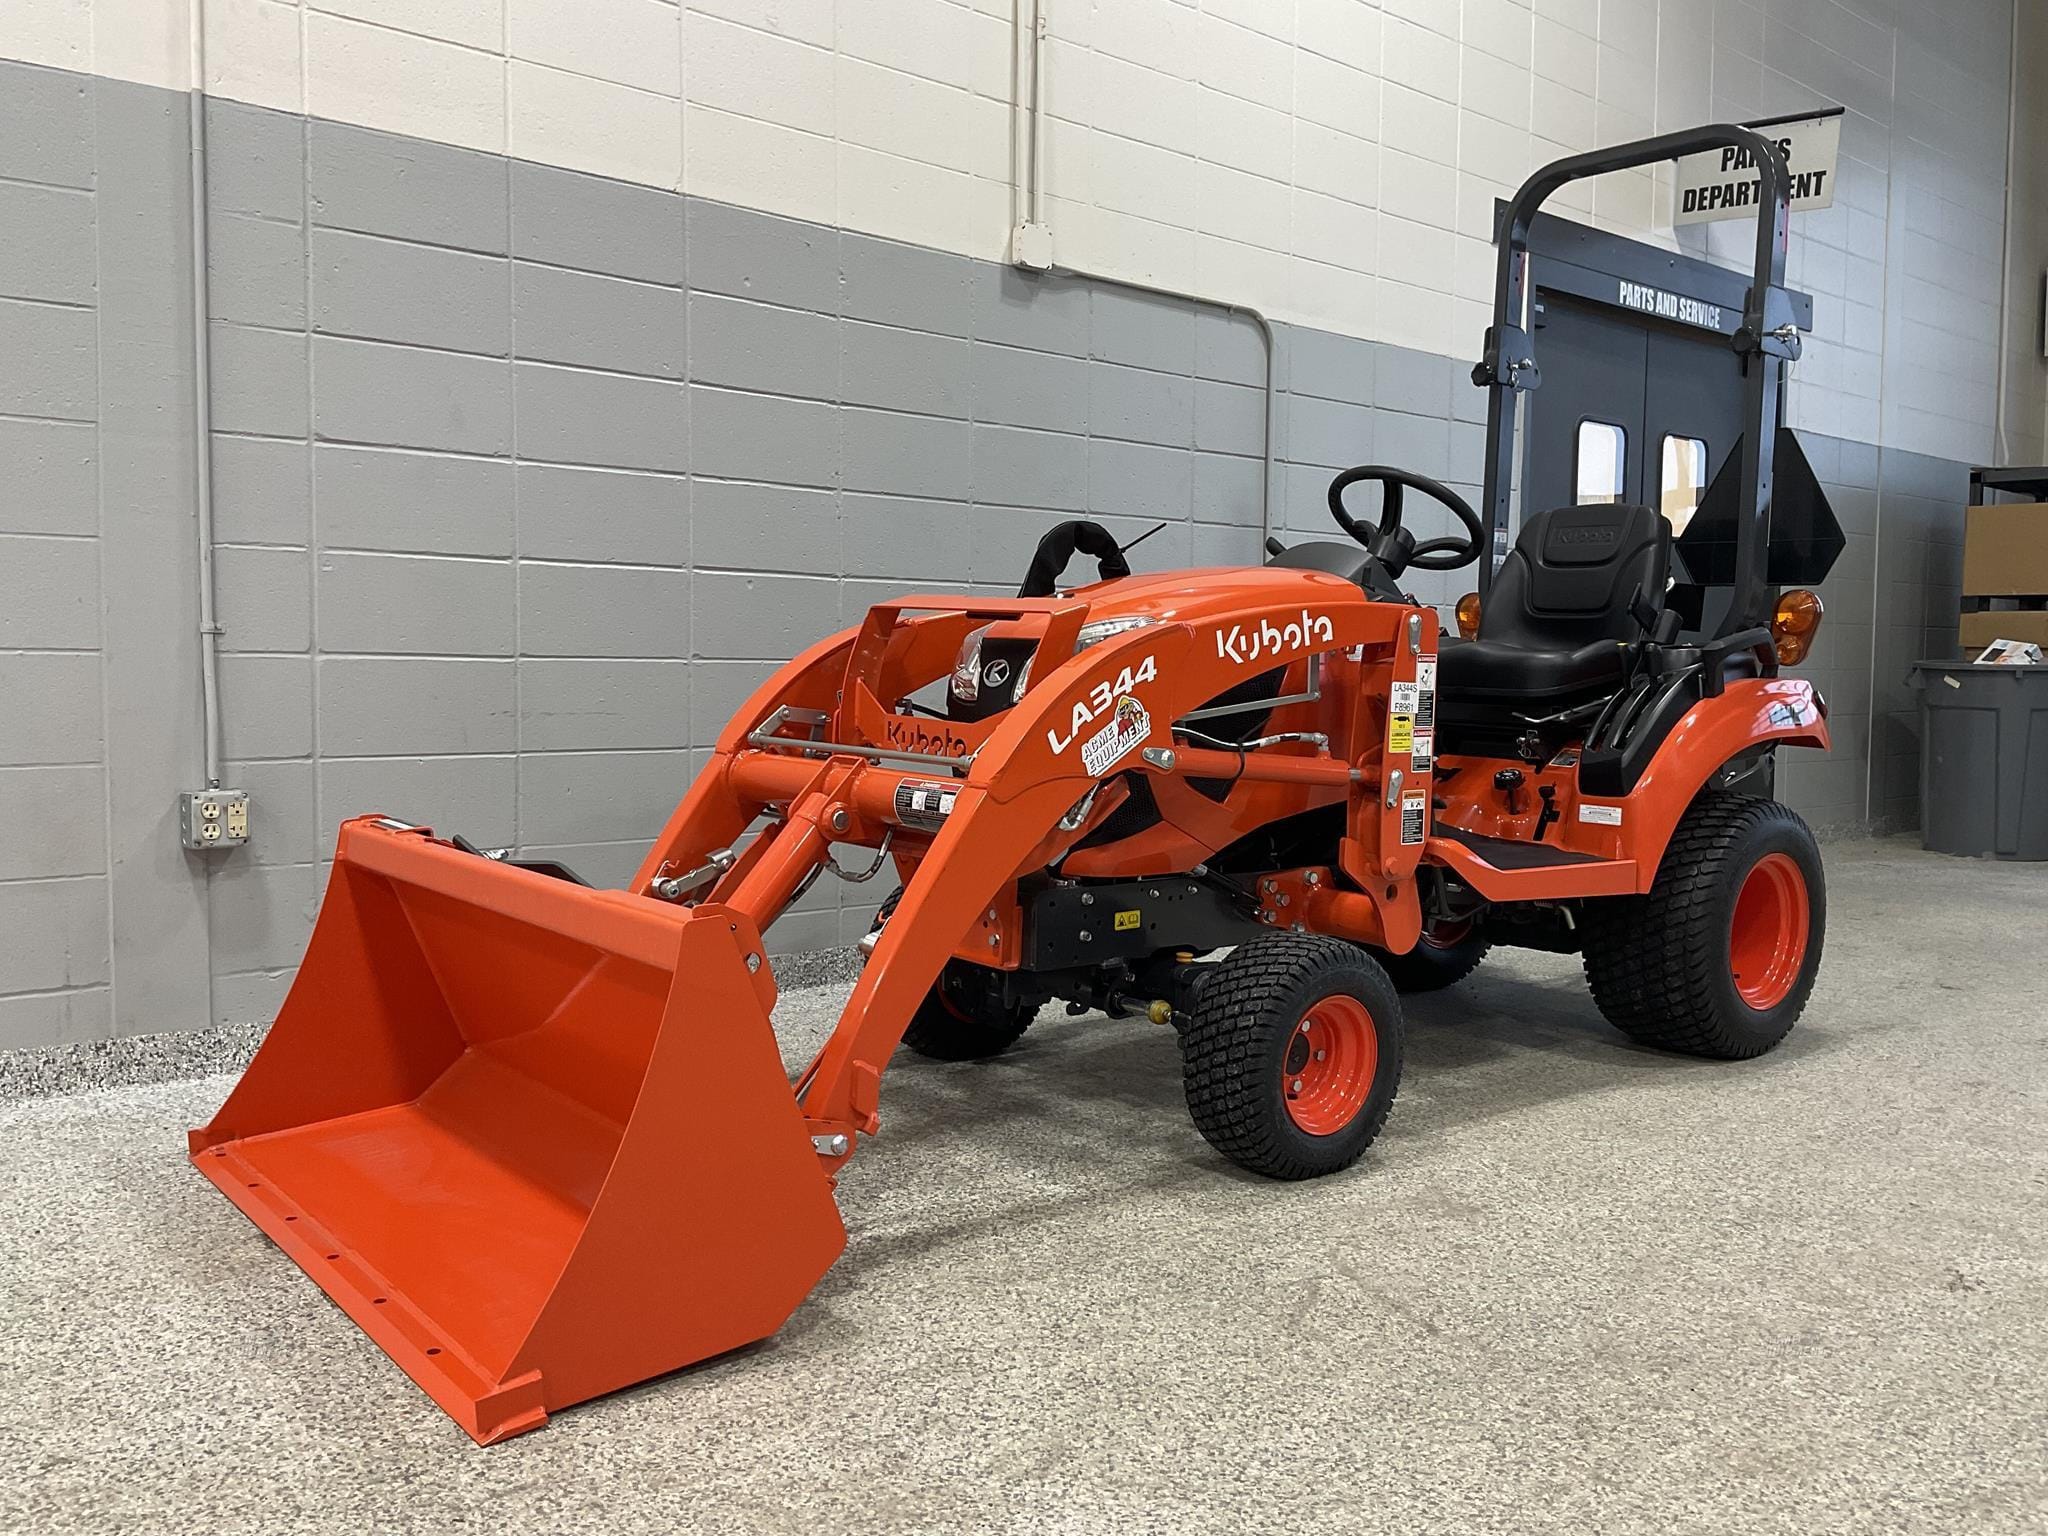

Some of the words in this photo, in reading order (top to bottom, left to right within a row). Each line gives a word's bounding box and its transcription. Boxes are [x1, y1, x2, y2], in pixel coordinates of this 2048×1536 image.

[1620, 281, 1654, 312] PARTS
[1656, 291, 1677, 318] AND
[1679, 298, 1720, 329] SERVICE
[1216, 609, 1333, 664] Kubota
[1047, 655, 1158, 755] LA344
[1394, 683, 1418, 693] LA344S
[887, 721, 967, 758] Kubota
[1083, 725, 1117, 761] ACME
[1087, 713, 1152, 776] EQUIPMENT
